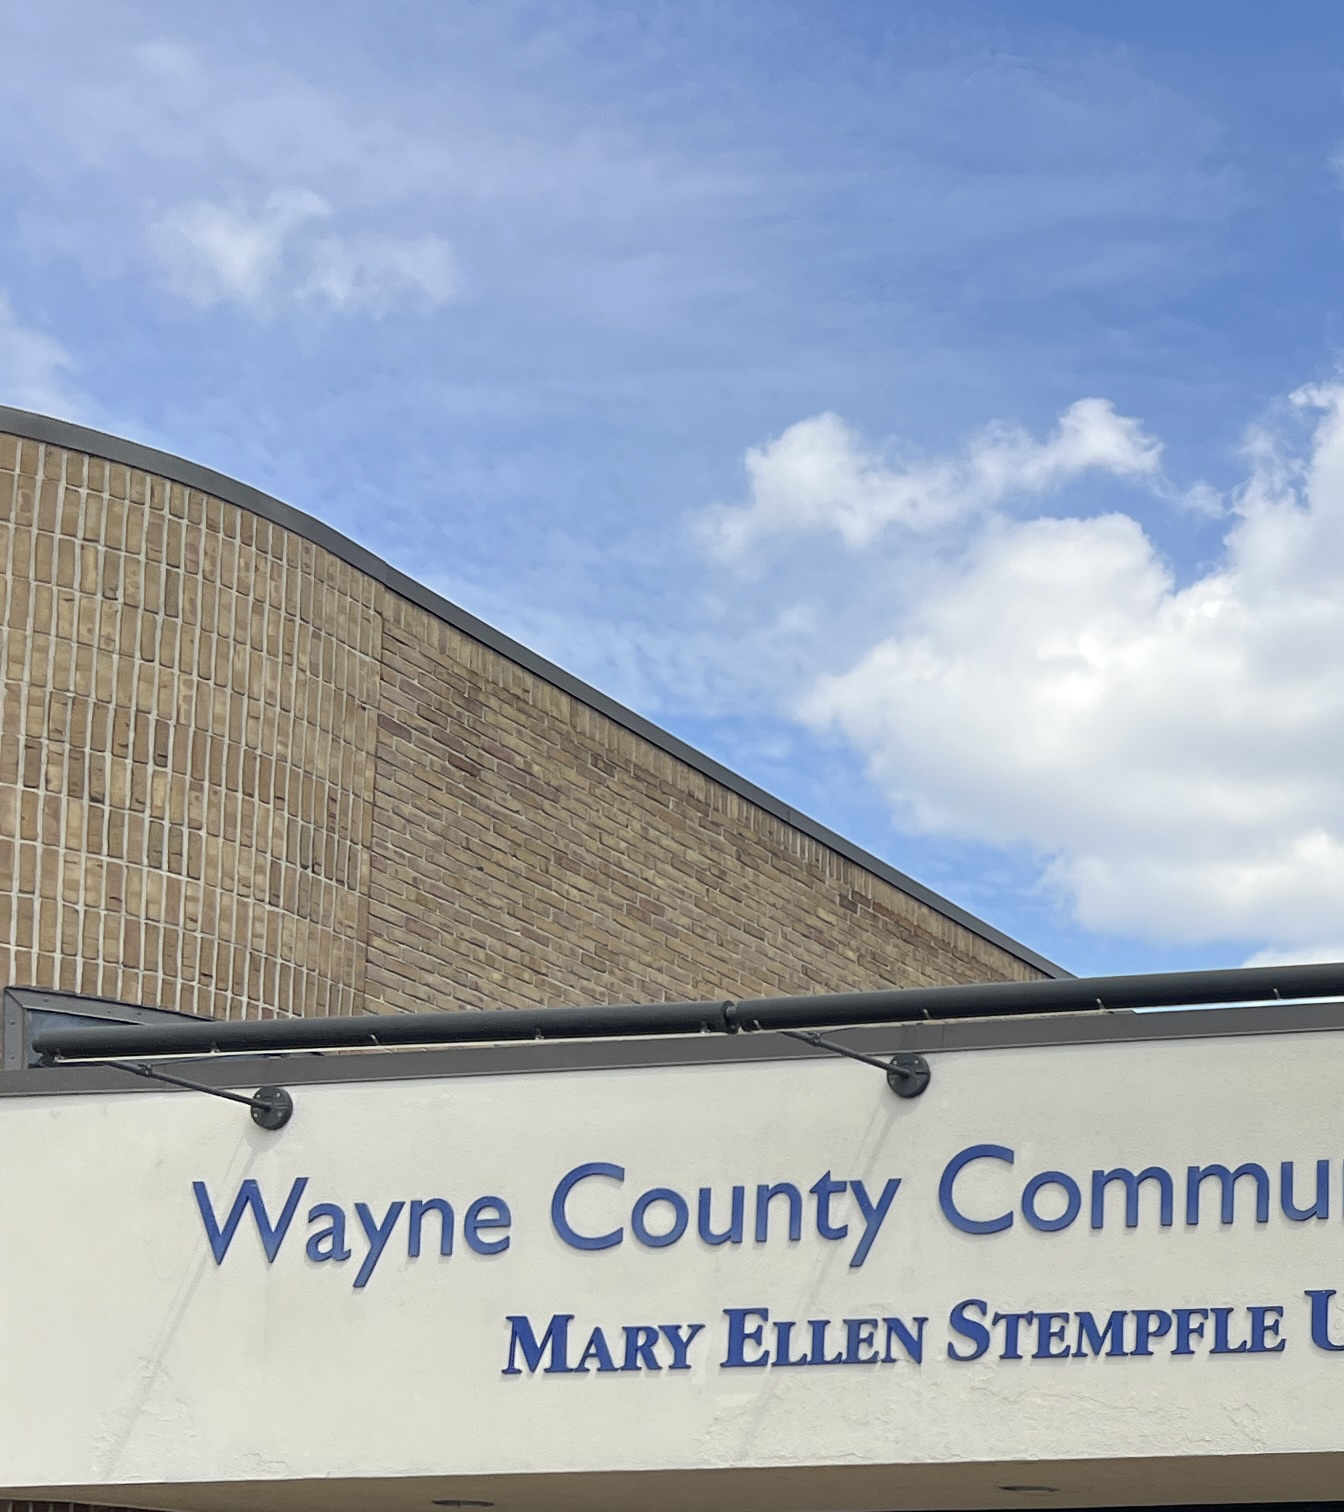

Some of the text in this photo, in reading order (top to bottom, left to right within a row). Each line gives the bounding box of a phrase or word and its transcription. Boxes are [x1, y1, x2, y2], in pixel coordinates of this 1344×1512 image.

[194, 1178, 512, 1287] Wayne
[551, 1162, 901, 1267] County
[501, 1314, 706, 1375] MARY
[720, 1308, 926, 1368] ELLEN
[946, 1299, 1287, 1361] STEMPFLE
